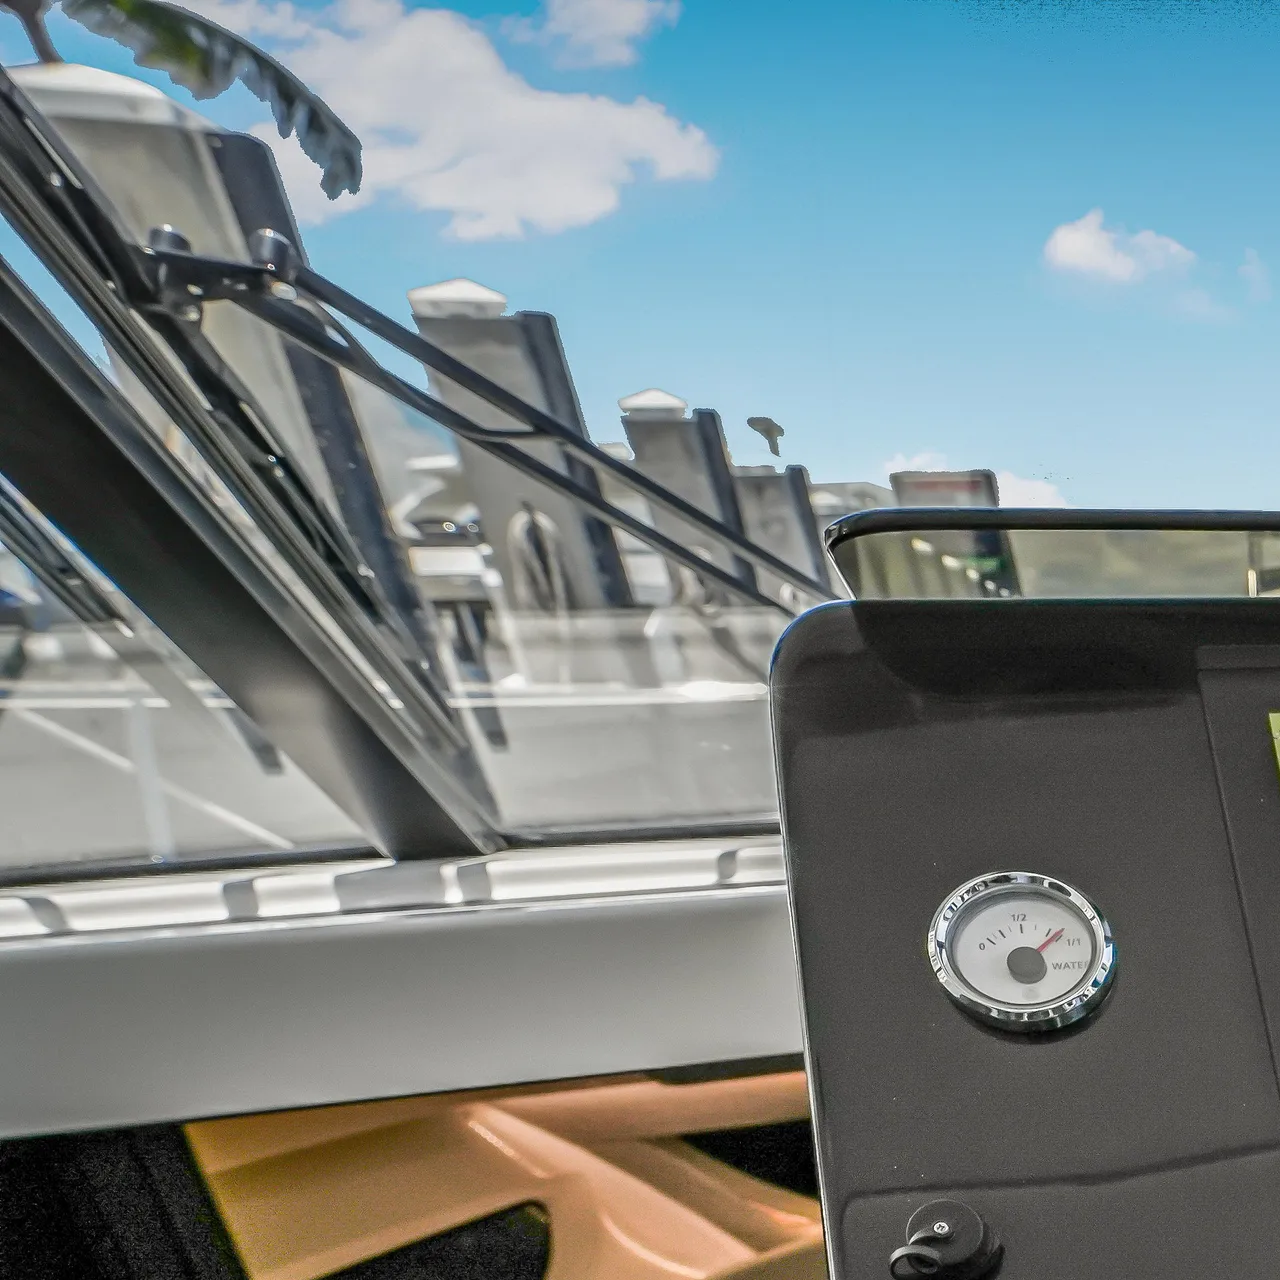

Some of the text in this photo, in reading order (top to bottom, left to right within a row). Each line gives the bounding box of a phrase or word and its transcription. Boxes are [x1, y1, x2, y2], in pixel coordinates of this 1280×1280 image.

[1011, 913, 1027, 922] 1/2
[979, 942, 986, 951] 0
[1066, 938, 1081, 947] 1/1
